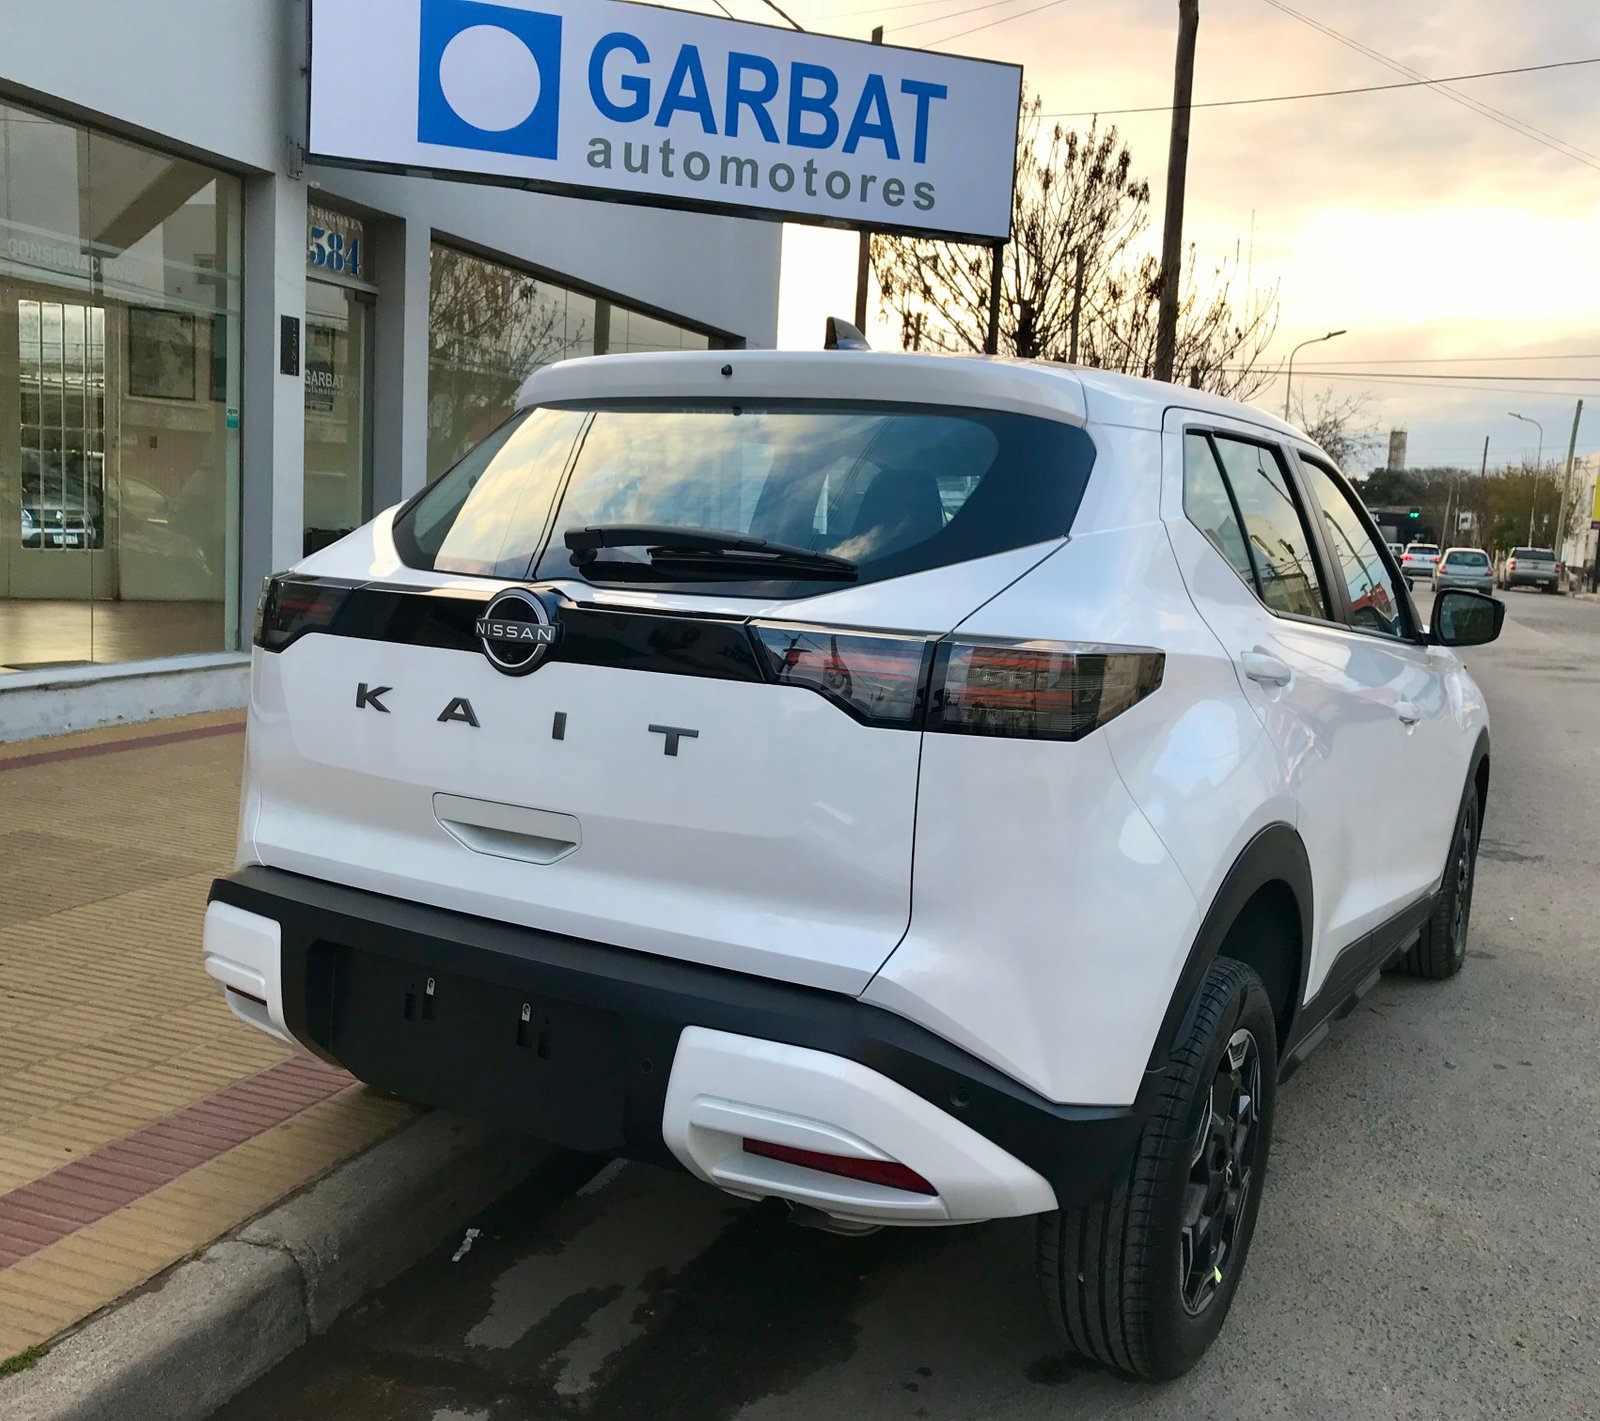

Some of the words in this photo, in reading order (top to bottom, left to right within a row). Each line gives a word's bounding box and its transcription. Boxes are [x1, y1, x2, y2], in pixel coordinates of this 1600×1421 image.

[588, 32, 948, 164] GARBAT
[587, 137, 936, 211] automotores
[304, 369, 344, 389] GARBAT
[476, 622, 552, 641] NISSAN
[355, 682, 699, 757] KAIT
